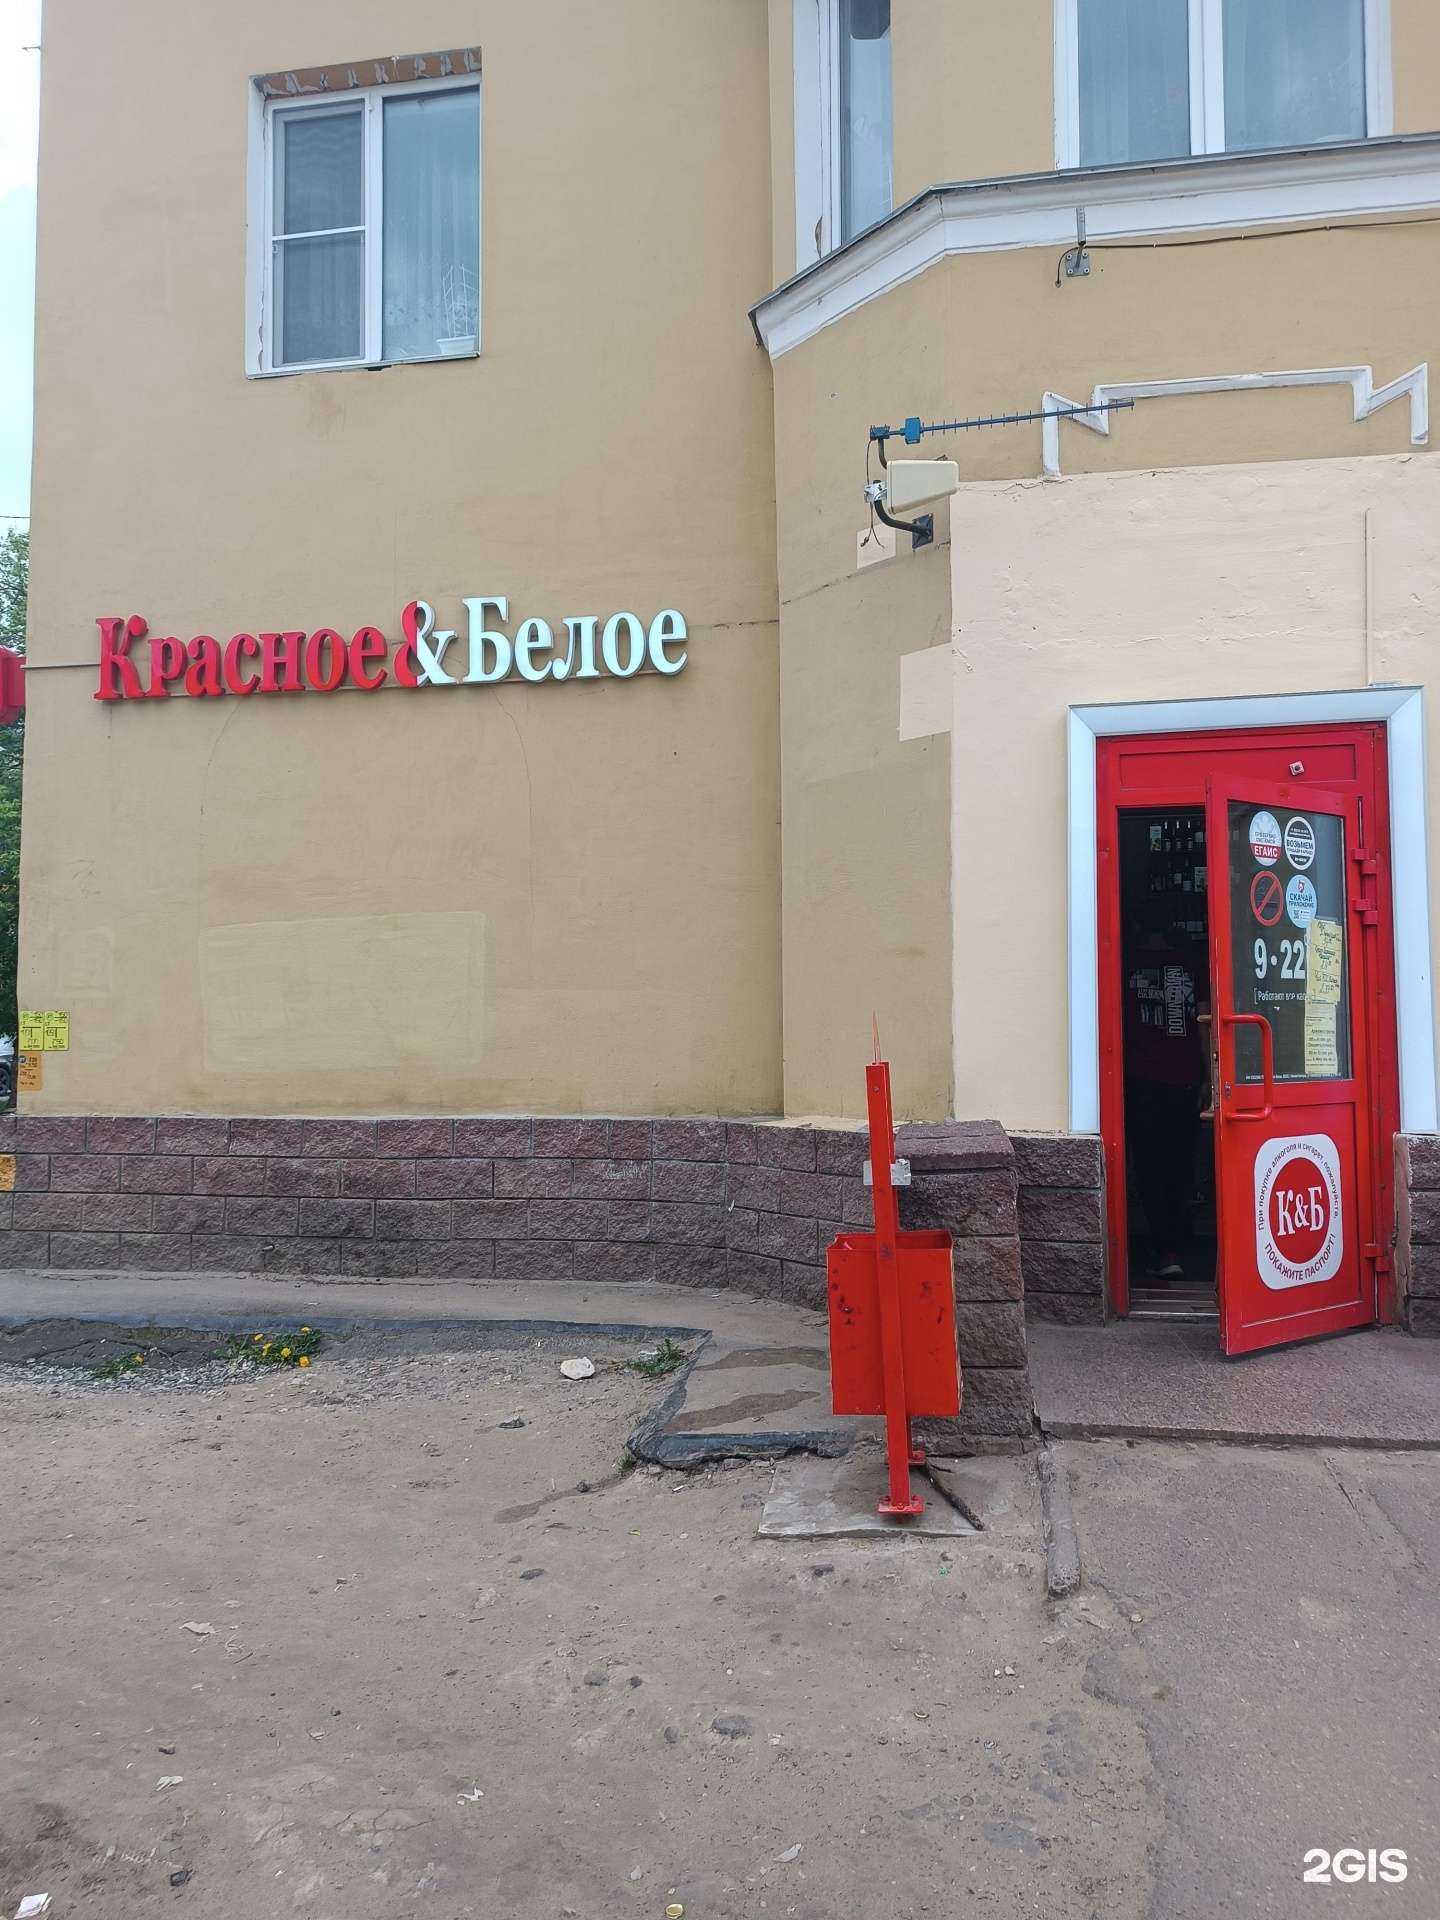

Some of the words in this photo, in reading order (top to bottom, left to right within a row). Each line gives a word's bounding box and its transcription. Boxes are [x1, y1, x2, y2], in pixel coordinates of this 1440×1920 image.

[1254, 845, 1278, 857] ЕГАИС
[1289, 892, 1313, 902] СКАЧАЙ
[1258, 1167, 1273, 1208] покупке
[1271, 1142, 1297, 1168] алкоголя
[1275, 1186, 1325, 1237] К&Б
[1264, 1242, 1304, 1281] ПОКАЖИТЕ
[1304, 1233, 1336, 1280] ПАСПОРТ!
